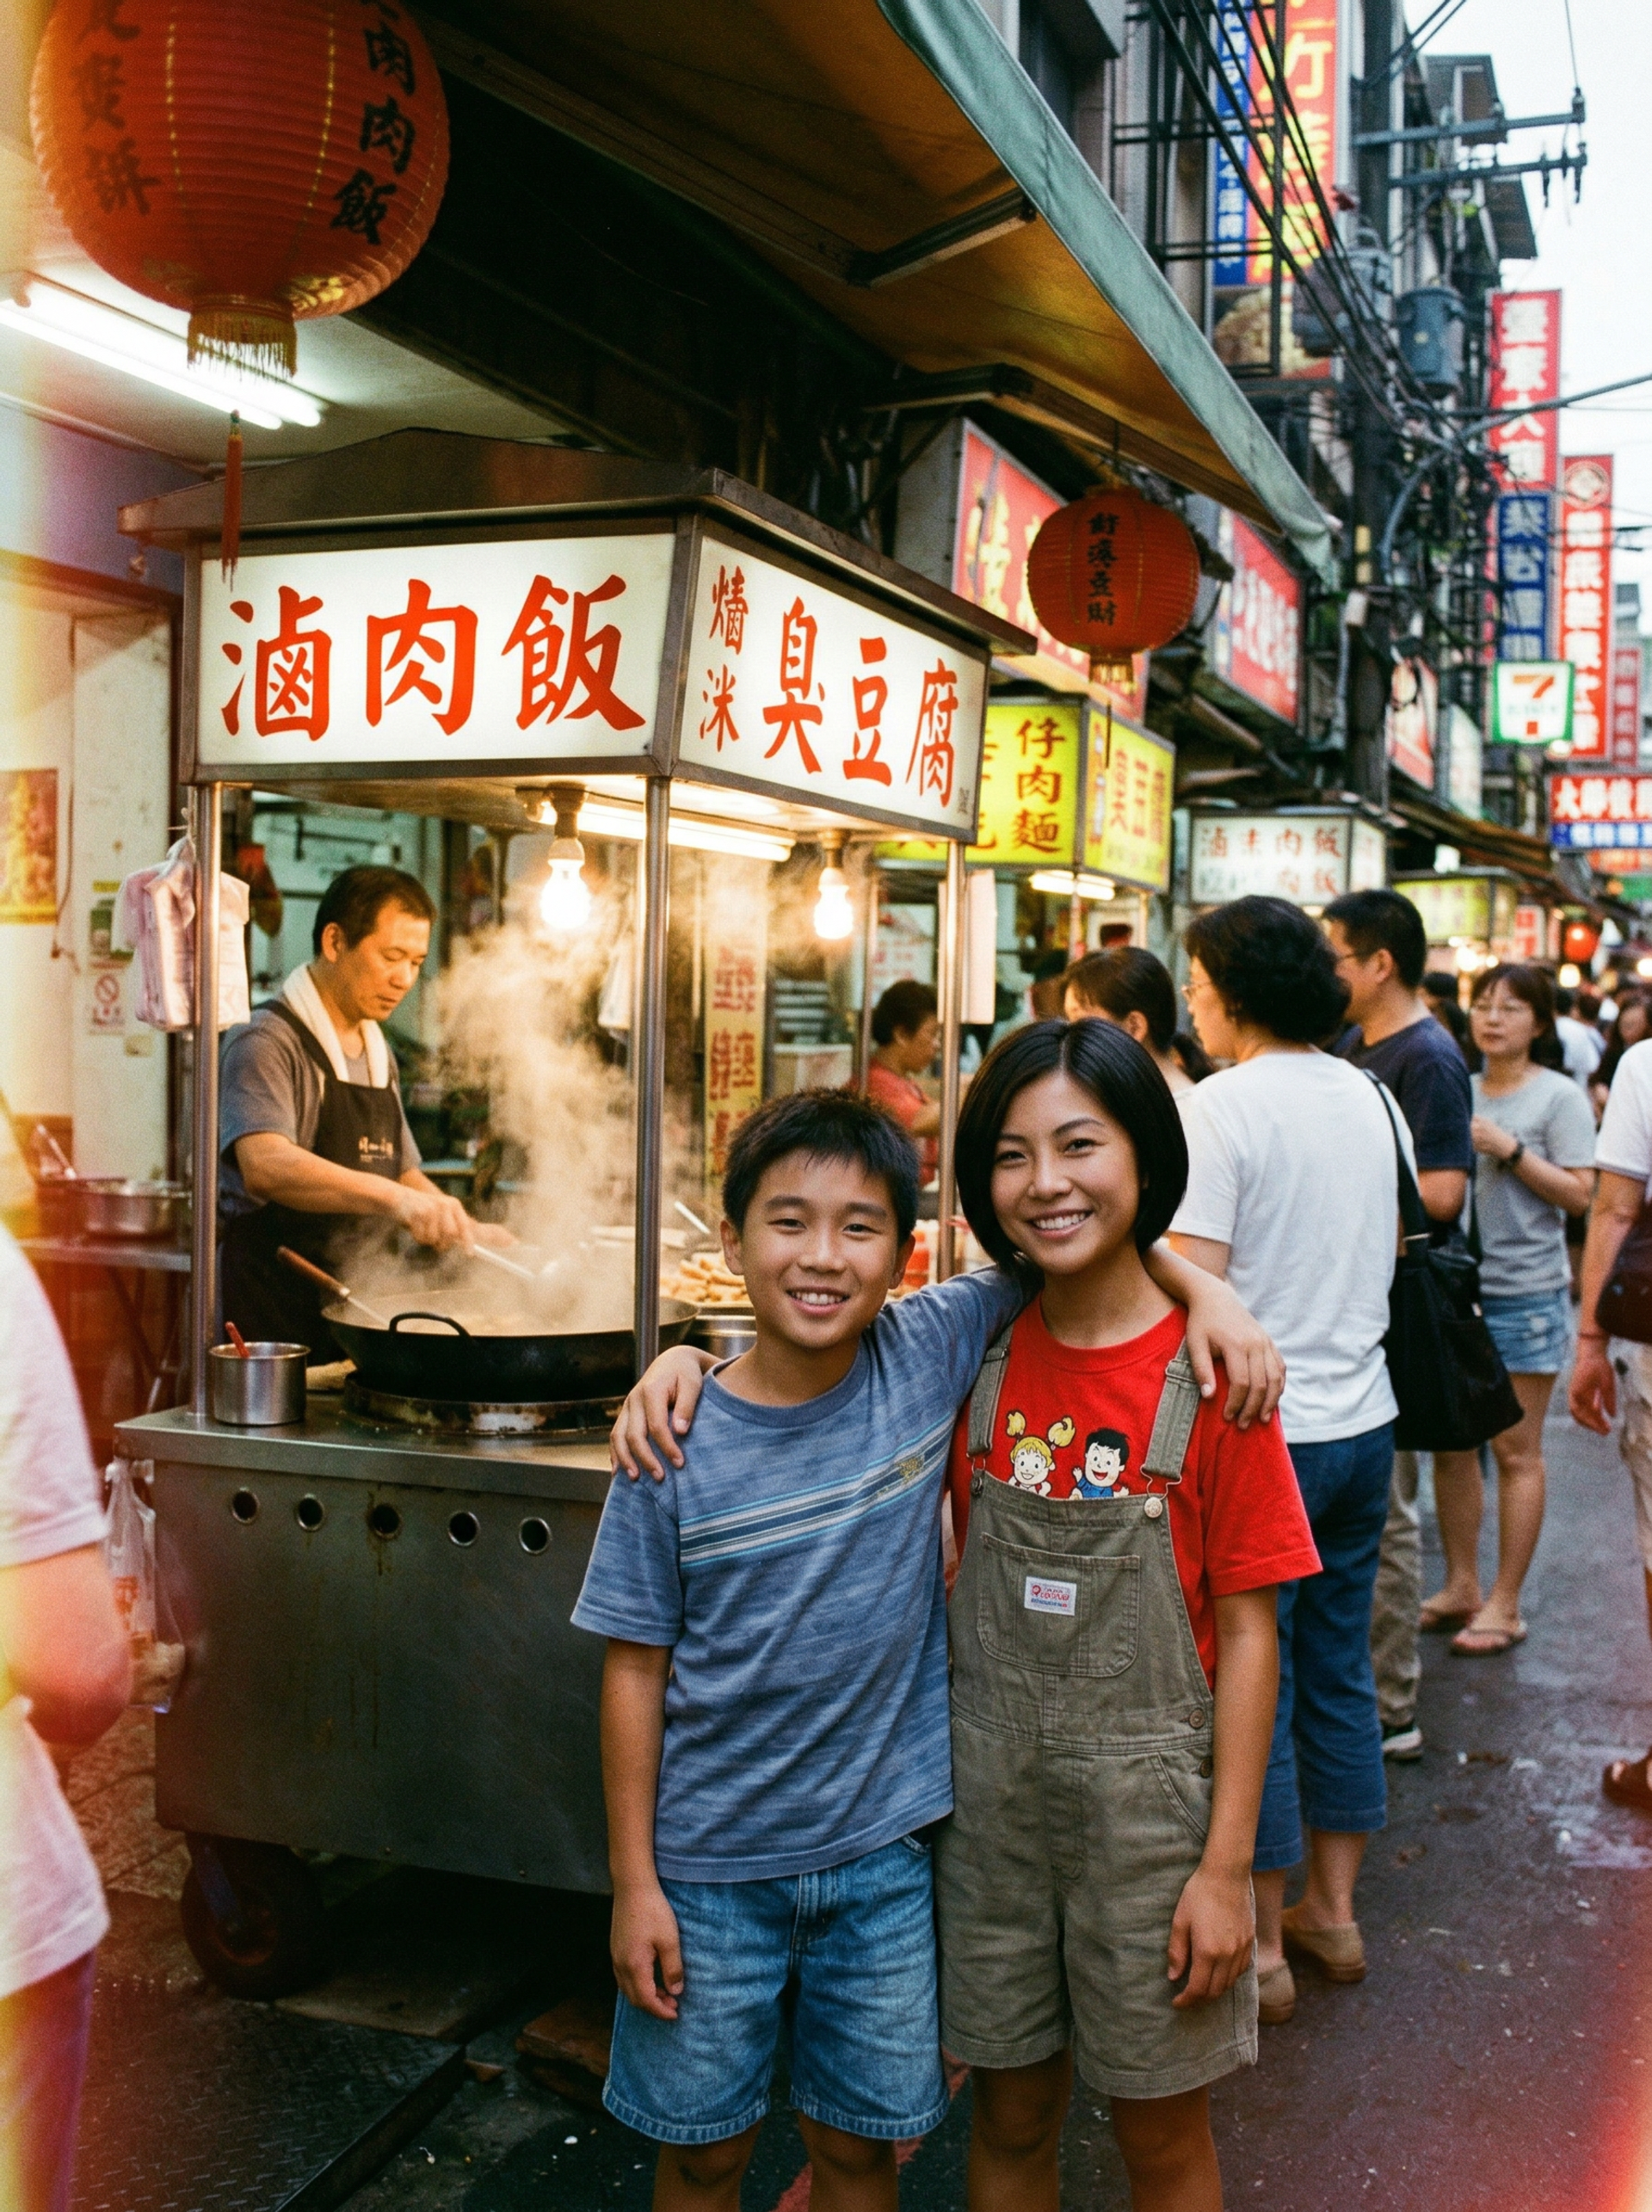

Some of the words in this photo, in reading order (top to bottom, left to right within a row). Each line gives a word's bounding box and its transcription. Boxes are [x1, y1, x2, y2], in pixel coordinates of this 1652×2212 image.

[221, 573, 647, 742] 滷肉飯
[762, 595, 959, 809] 臭豆腐
[1012, 717, 1068, 854] 仔肉麵
